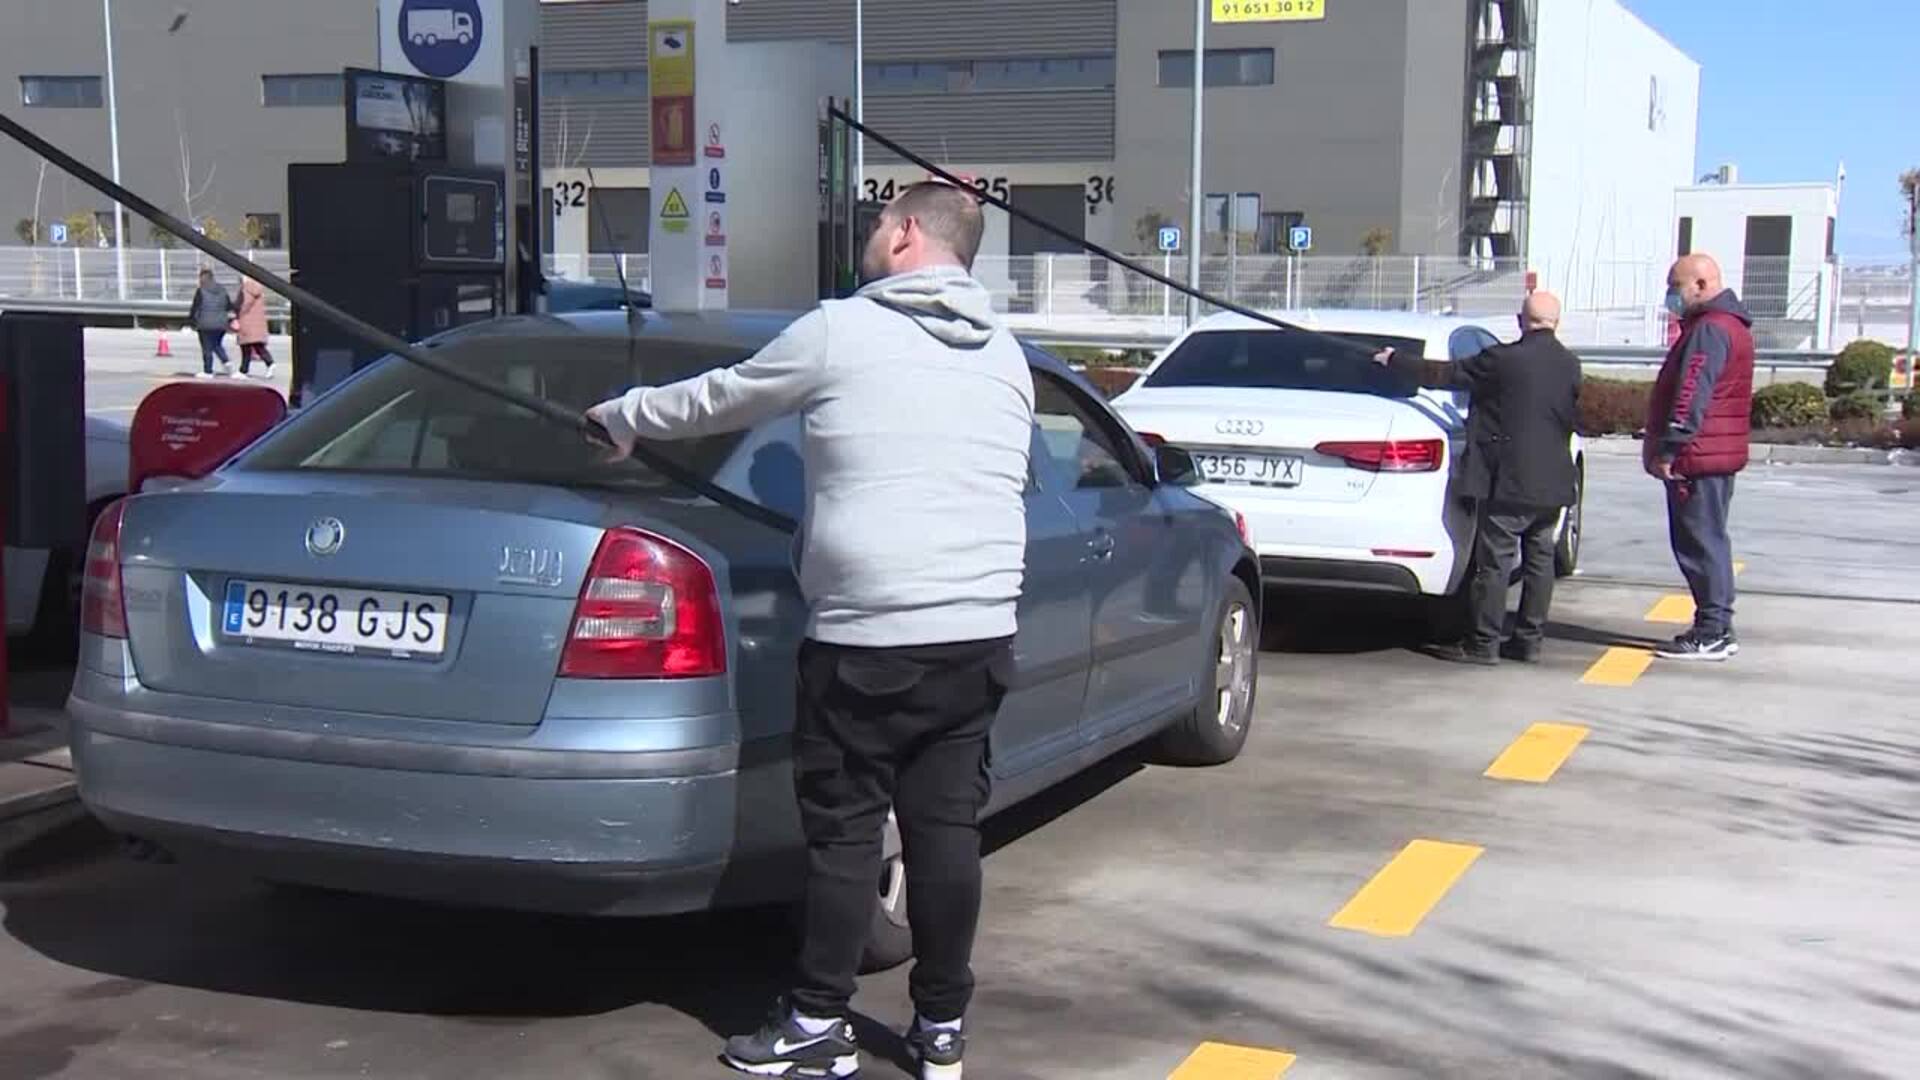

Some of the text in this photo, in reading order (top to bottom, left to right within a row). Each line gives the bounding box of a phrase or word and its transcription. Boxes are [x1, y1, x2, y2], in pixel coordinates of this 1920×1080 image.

[1222, 1, 1315, 14] 91 651 30 12
[1254, 457, 1294, 479] JYX
[246, 588, 436, 643] 9138 GJS
